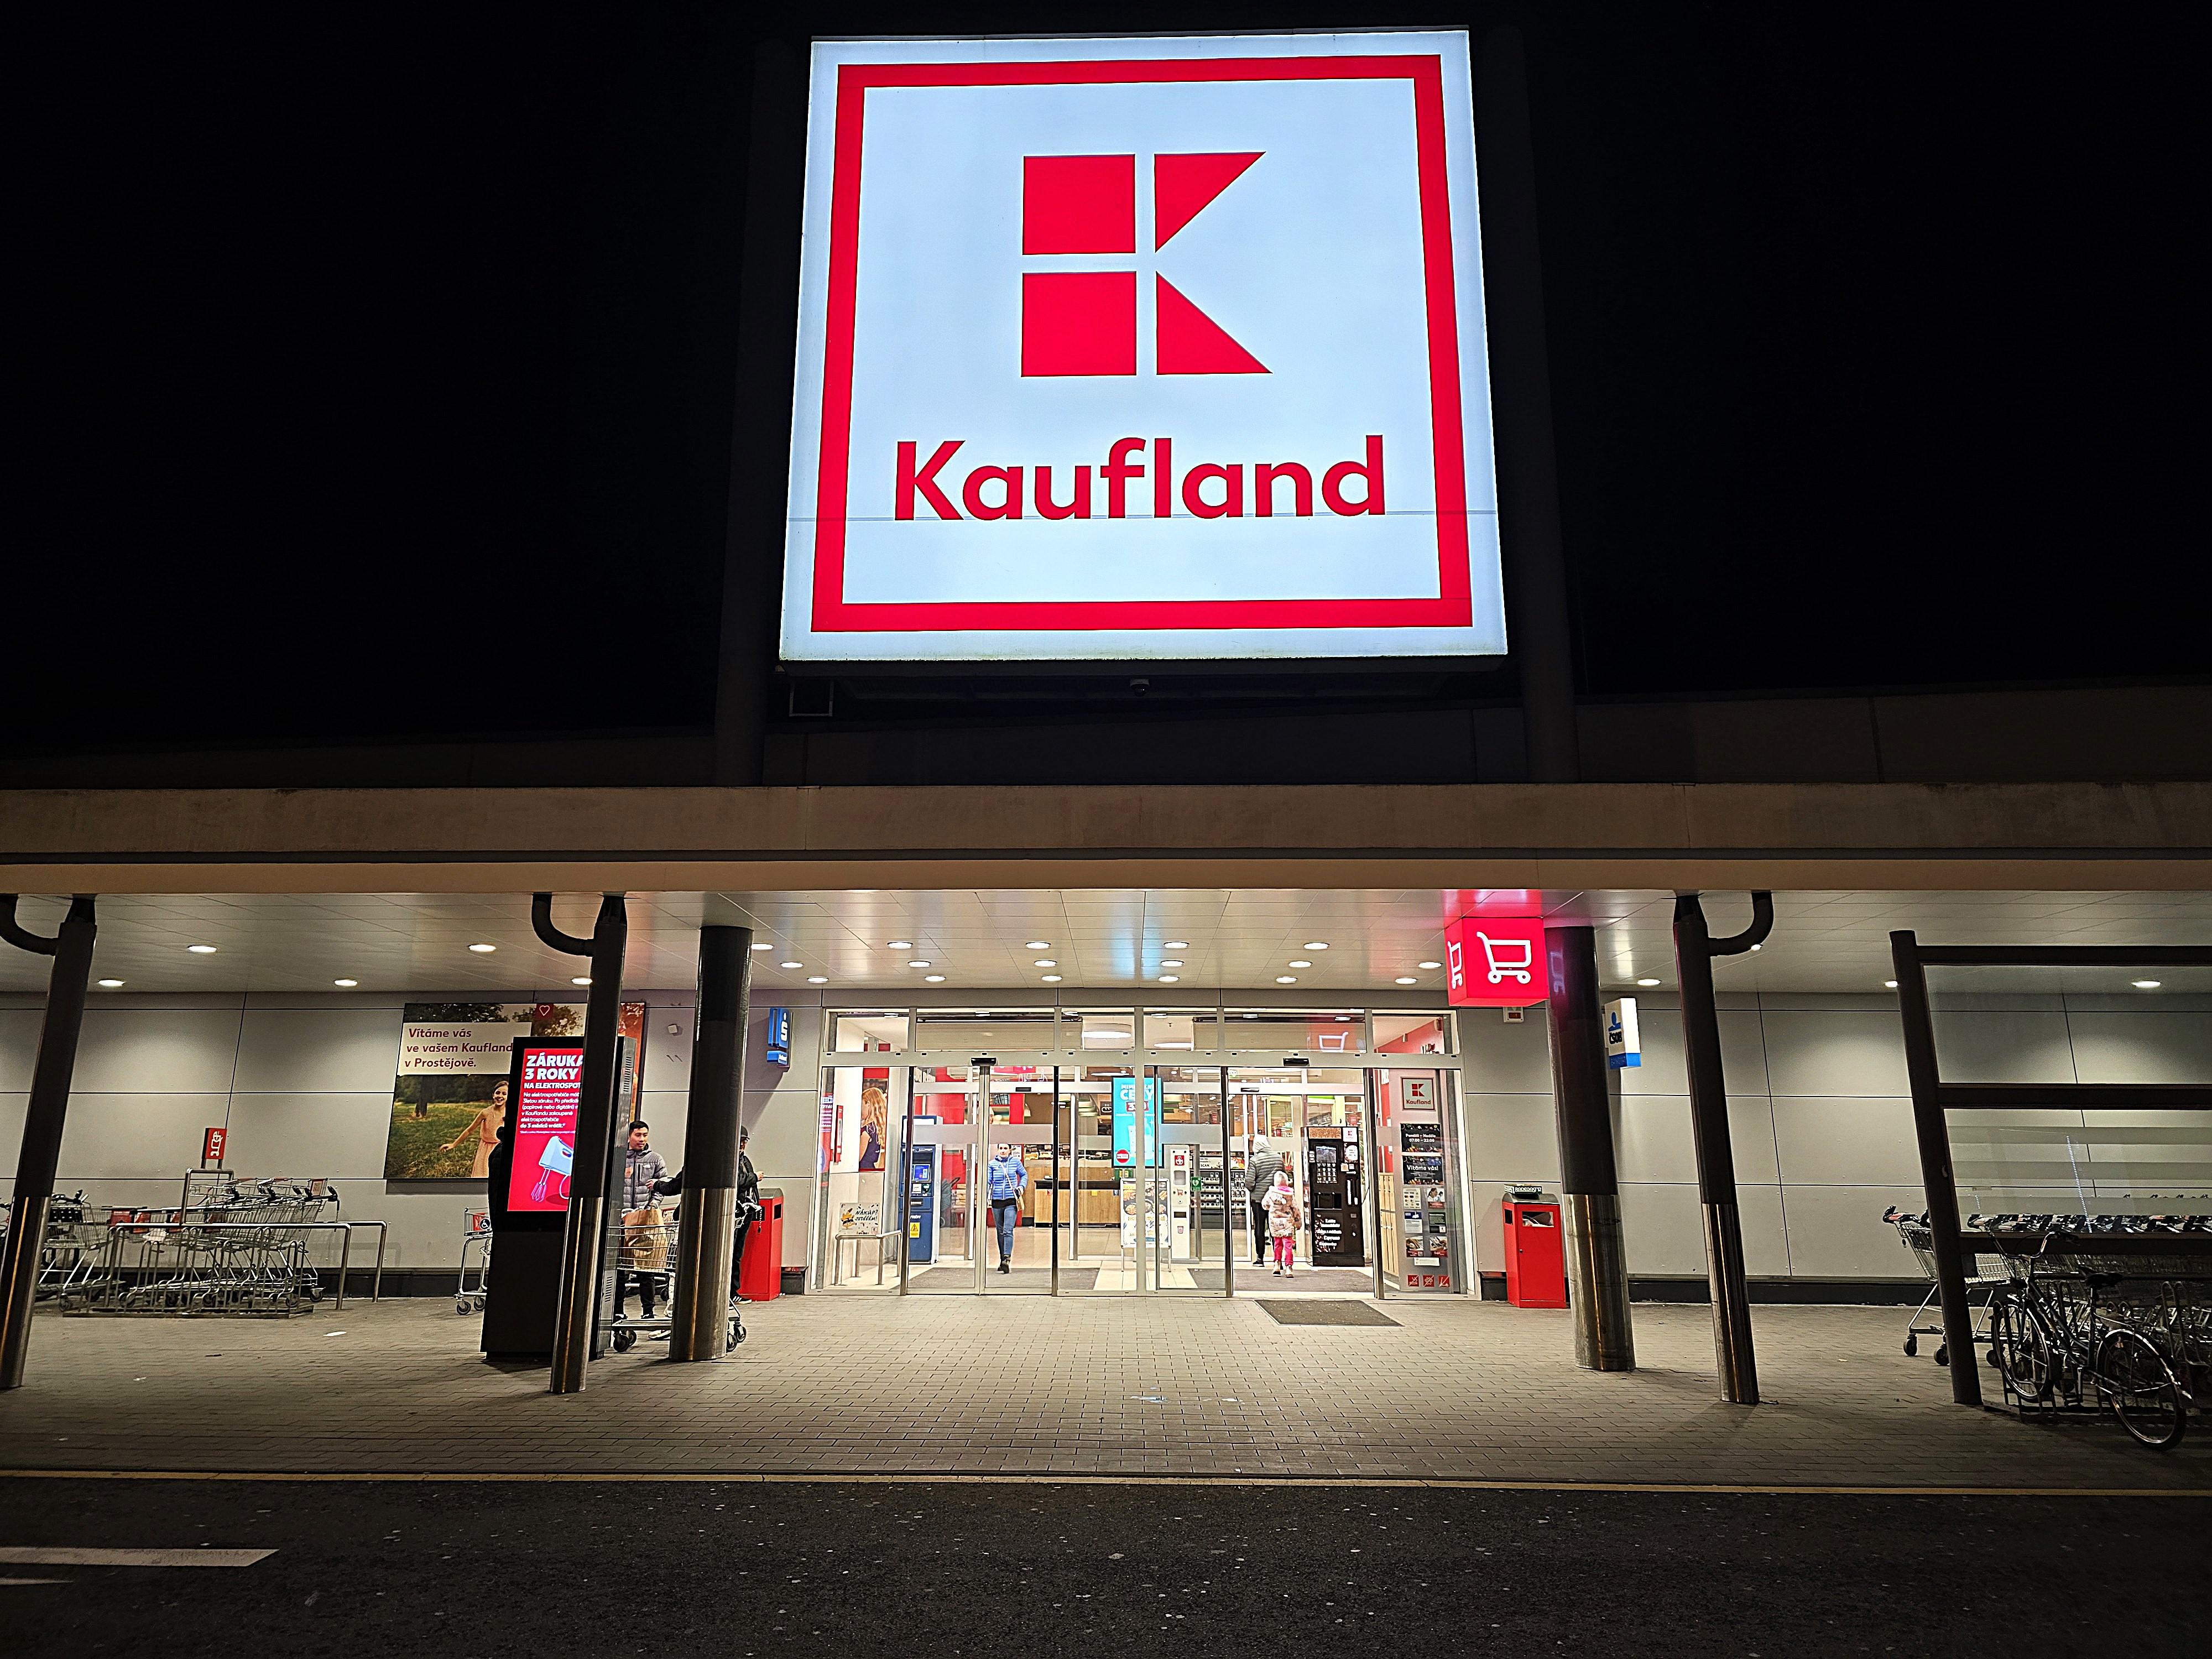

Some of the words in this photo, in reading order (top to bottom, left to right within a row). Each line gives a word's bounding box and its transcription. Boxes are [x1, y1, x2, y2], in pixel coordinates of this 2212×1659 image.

[1021, 152, 1273, 377] K
[895, 435, 1386, 521] Kaufland
[409, 1028, 449, 1037] Vítáme
[453, 1028, 472, 1037] vás
[422, 1043, 461, 1052] vašem
[414, 1057, 477, 1070] Prostějově.
[526, 1052, 583, 1067] ZÁRUKA
[524, 1068, 535, 1080] 3
[536, 1068, 579, 1080] ROKY
[1120, 1089, 1154, 1100] CEY
